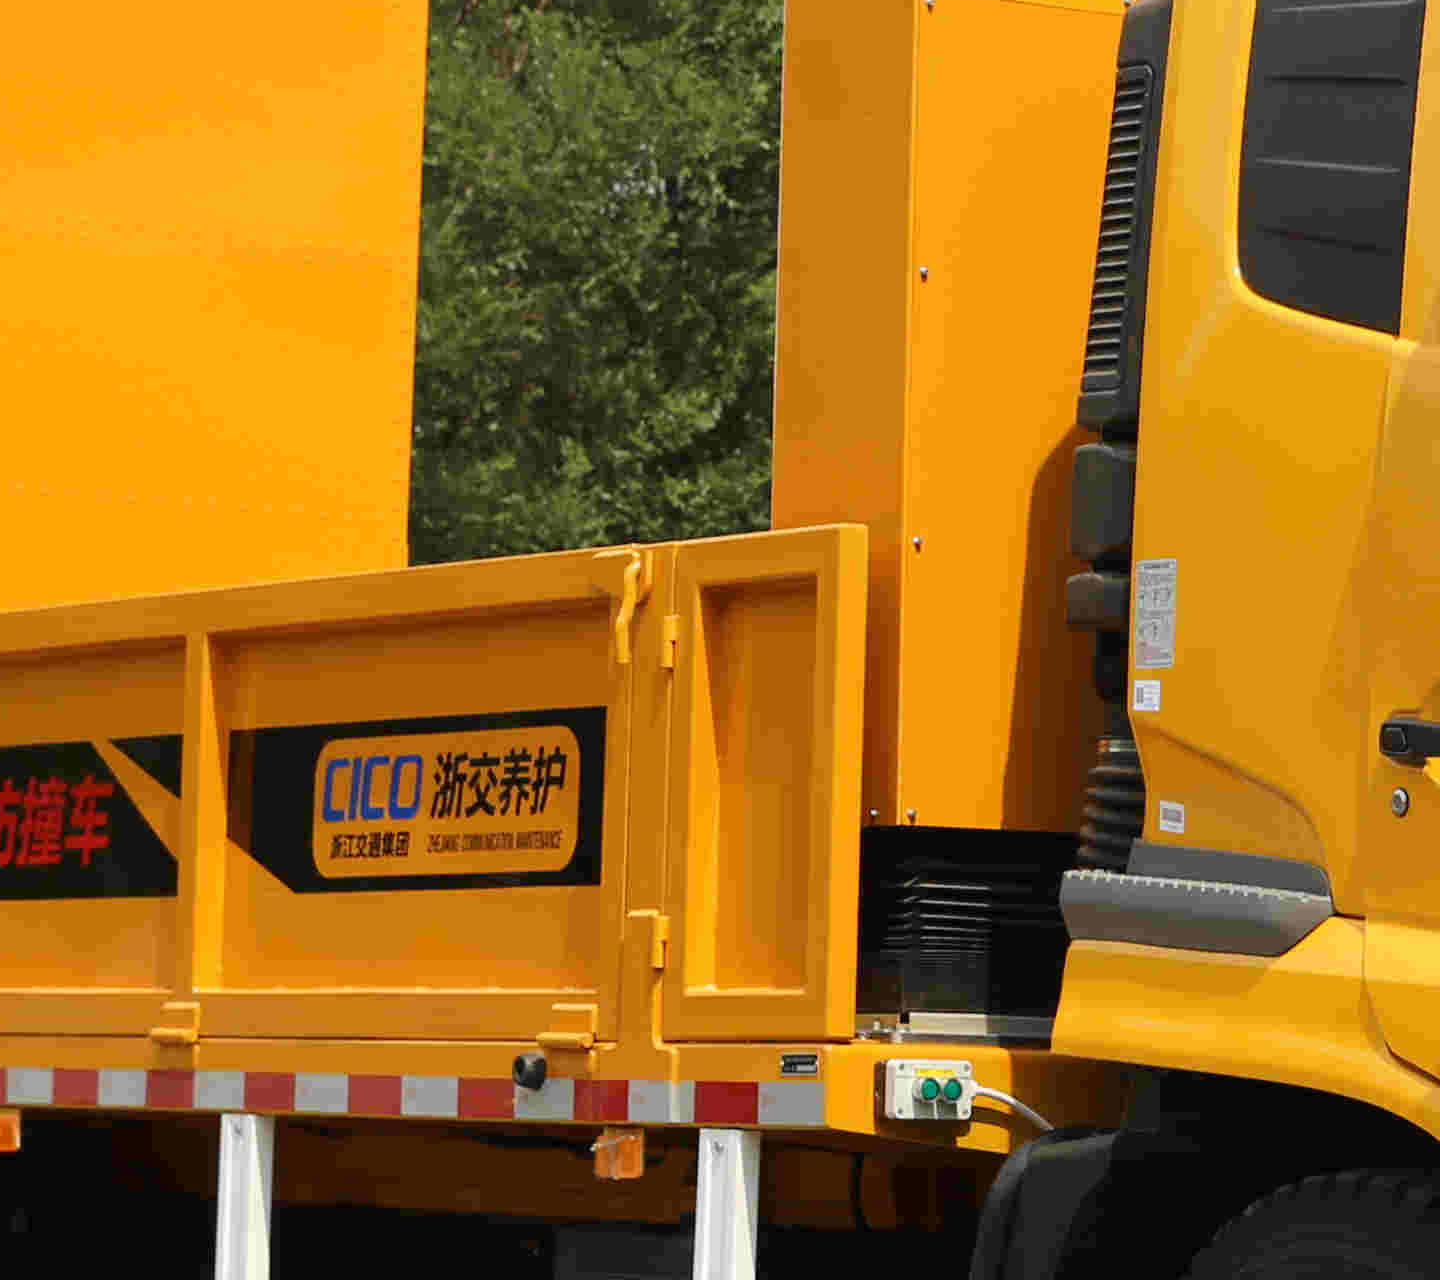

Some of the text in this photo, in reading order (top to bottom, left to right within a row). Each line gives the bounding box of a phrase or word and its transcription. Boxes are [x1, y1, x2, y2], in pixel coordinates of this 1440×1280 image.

[322, 745, 568, 822] CICO 浙交养护
